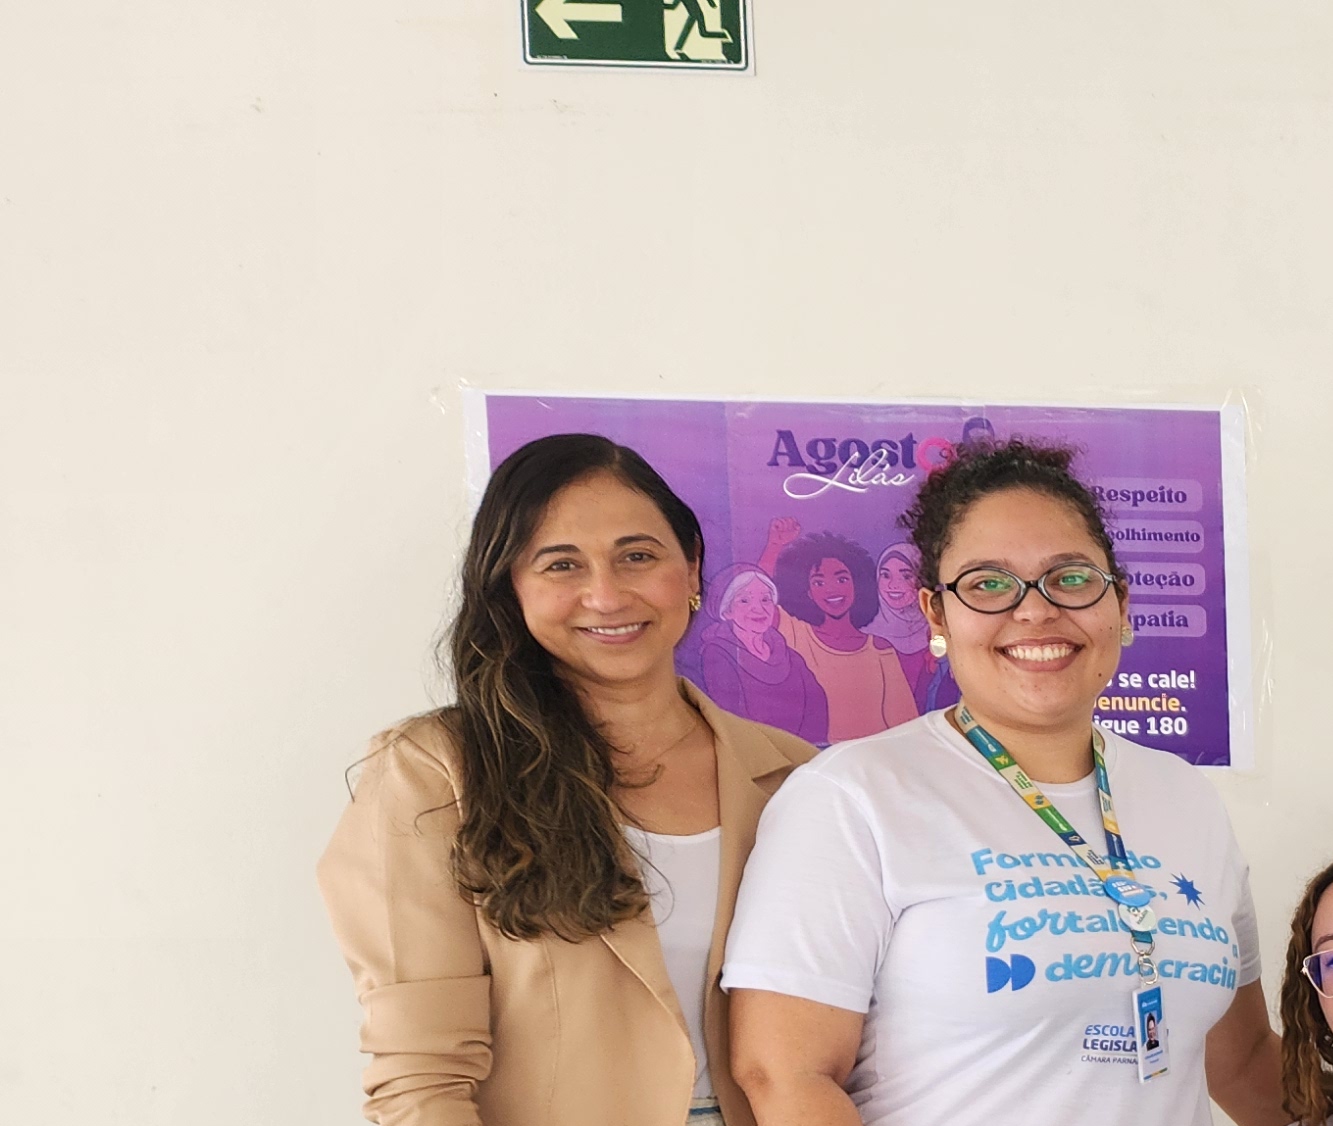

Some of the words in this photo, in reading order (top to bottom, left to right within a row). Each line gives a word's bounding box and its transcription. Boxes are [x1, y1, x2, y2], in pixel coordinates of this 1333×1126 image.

[766, 429, 955, 476] Agosto
[783, 448, 915, 500] Lilás
[1091, 485, 1188, 508] Respeito
[1130, 610, 1189, 632] patia
[1118, 671, 1142, 688] se
[1147, 670, 1195, 689] cale!
[1094, 693, 1187, 712] enuncie.
[1093, 714, 1140, 734] igue
[1146, 716, 1188, 735] 180
[970, 848, 1161, 875] Formdo
[985, 909, 1230, 953] fortalendo
[1085, 1024, 1136, 1037] ESCOLA
[1081, 1055, 1111, 1064] CÂMARA
